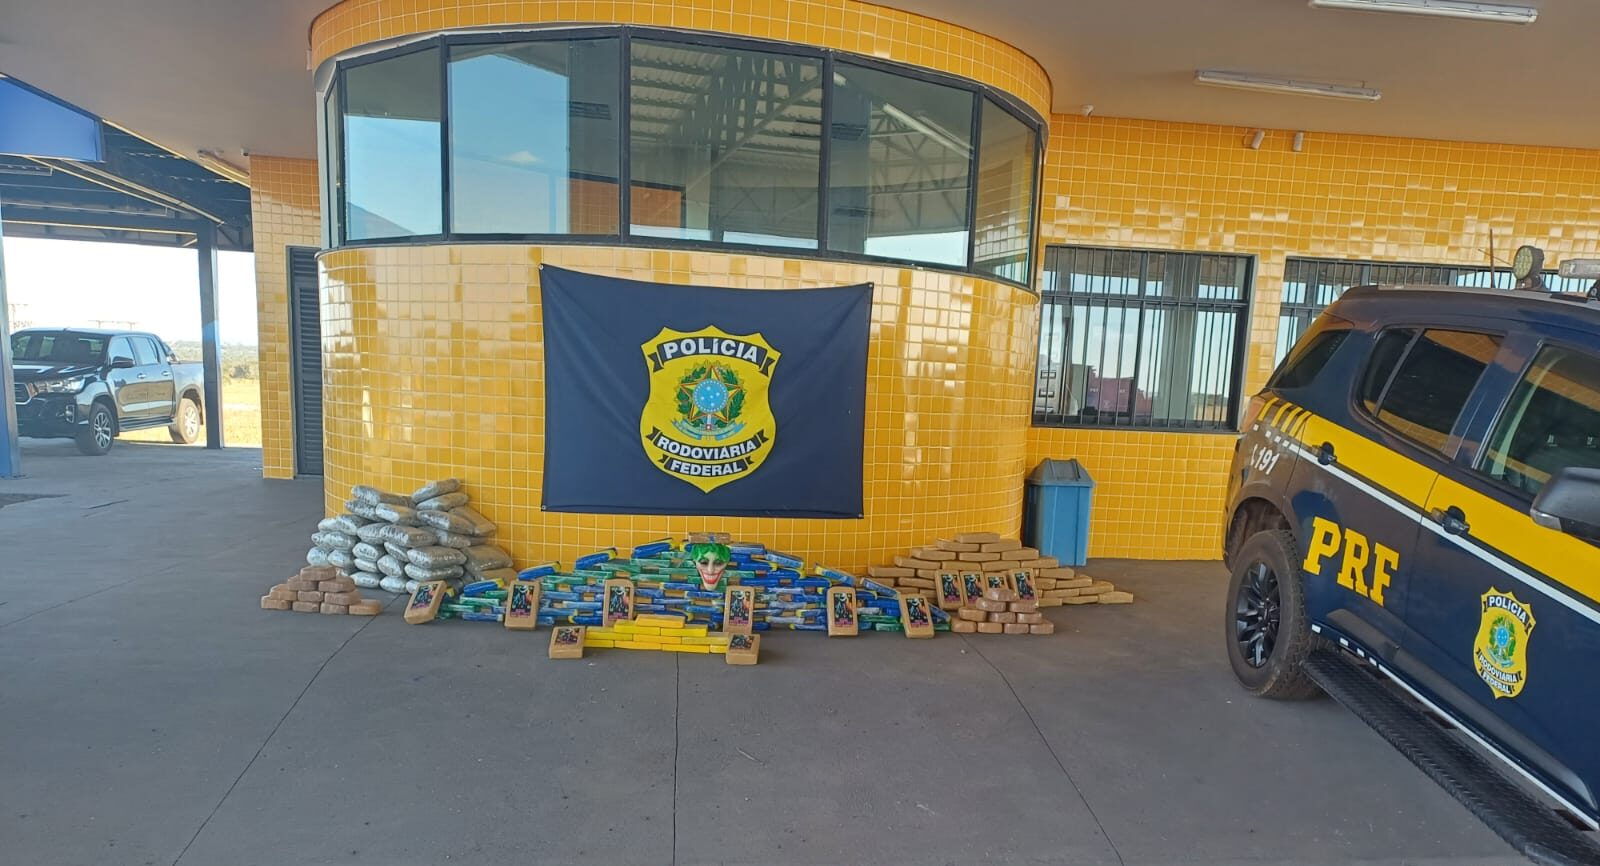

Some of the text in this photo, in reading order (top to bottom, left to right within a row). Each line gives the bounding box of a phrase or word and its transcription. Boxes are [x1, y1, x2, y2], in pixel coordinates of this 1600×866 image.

[663, 337, 758, 363] POLÍCIA
[657, 436, 757, 460] RODOVIÁRIA
[1254, 446, 1280, 475] 191
[670, 459, 743, 476] FEDERAL
[1303, 516, 1400, 607] PRF
[1483, 670, 1511, 694] FEDERAL
